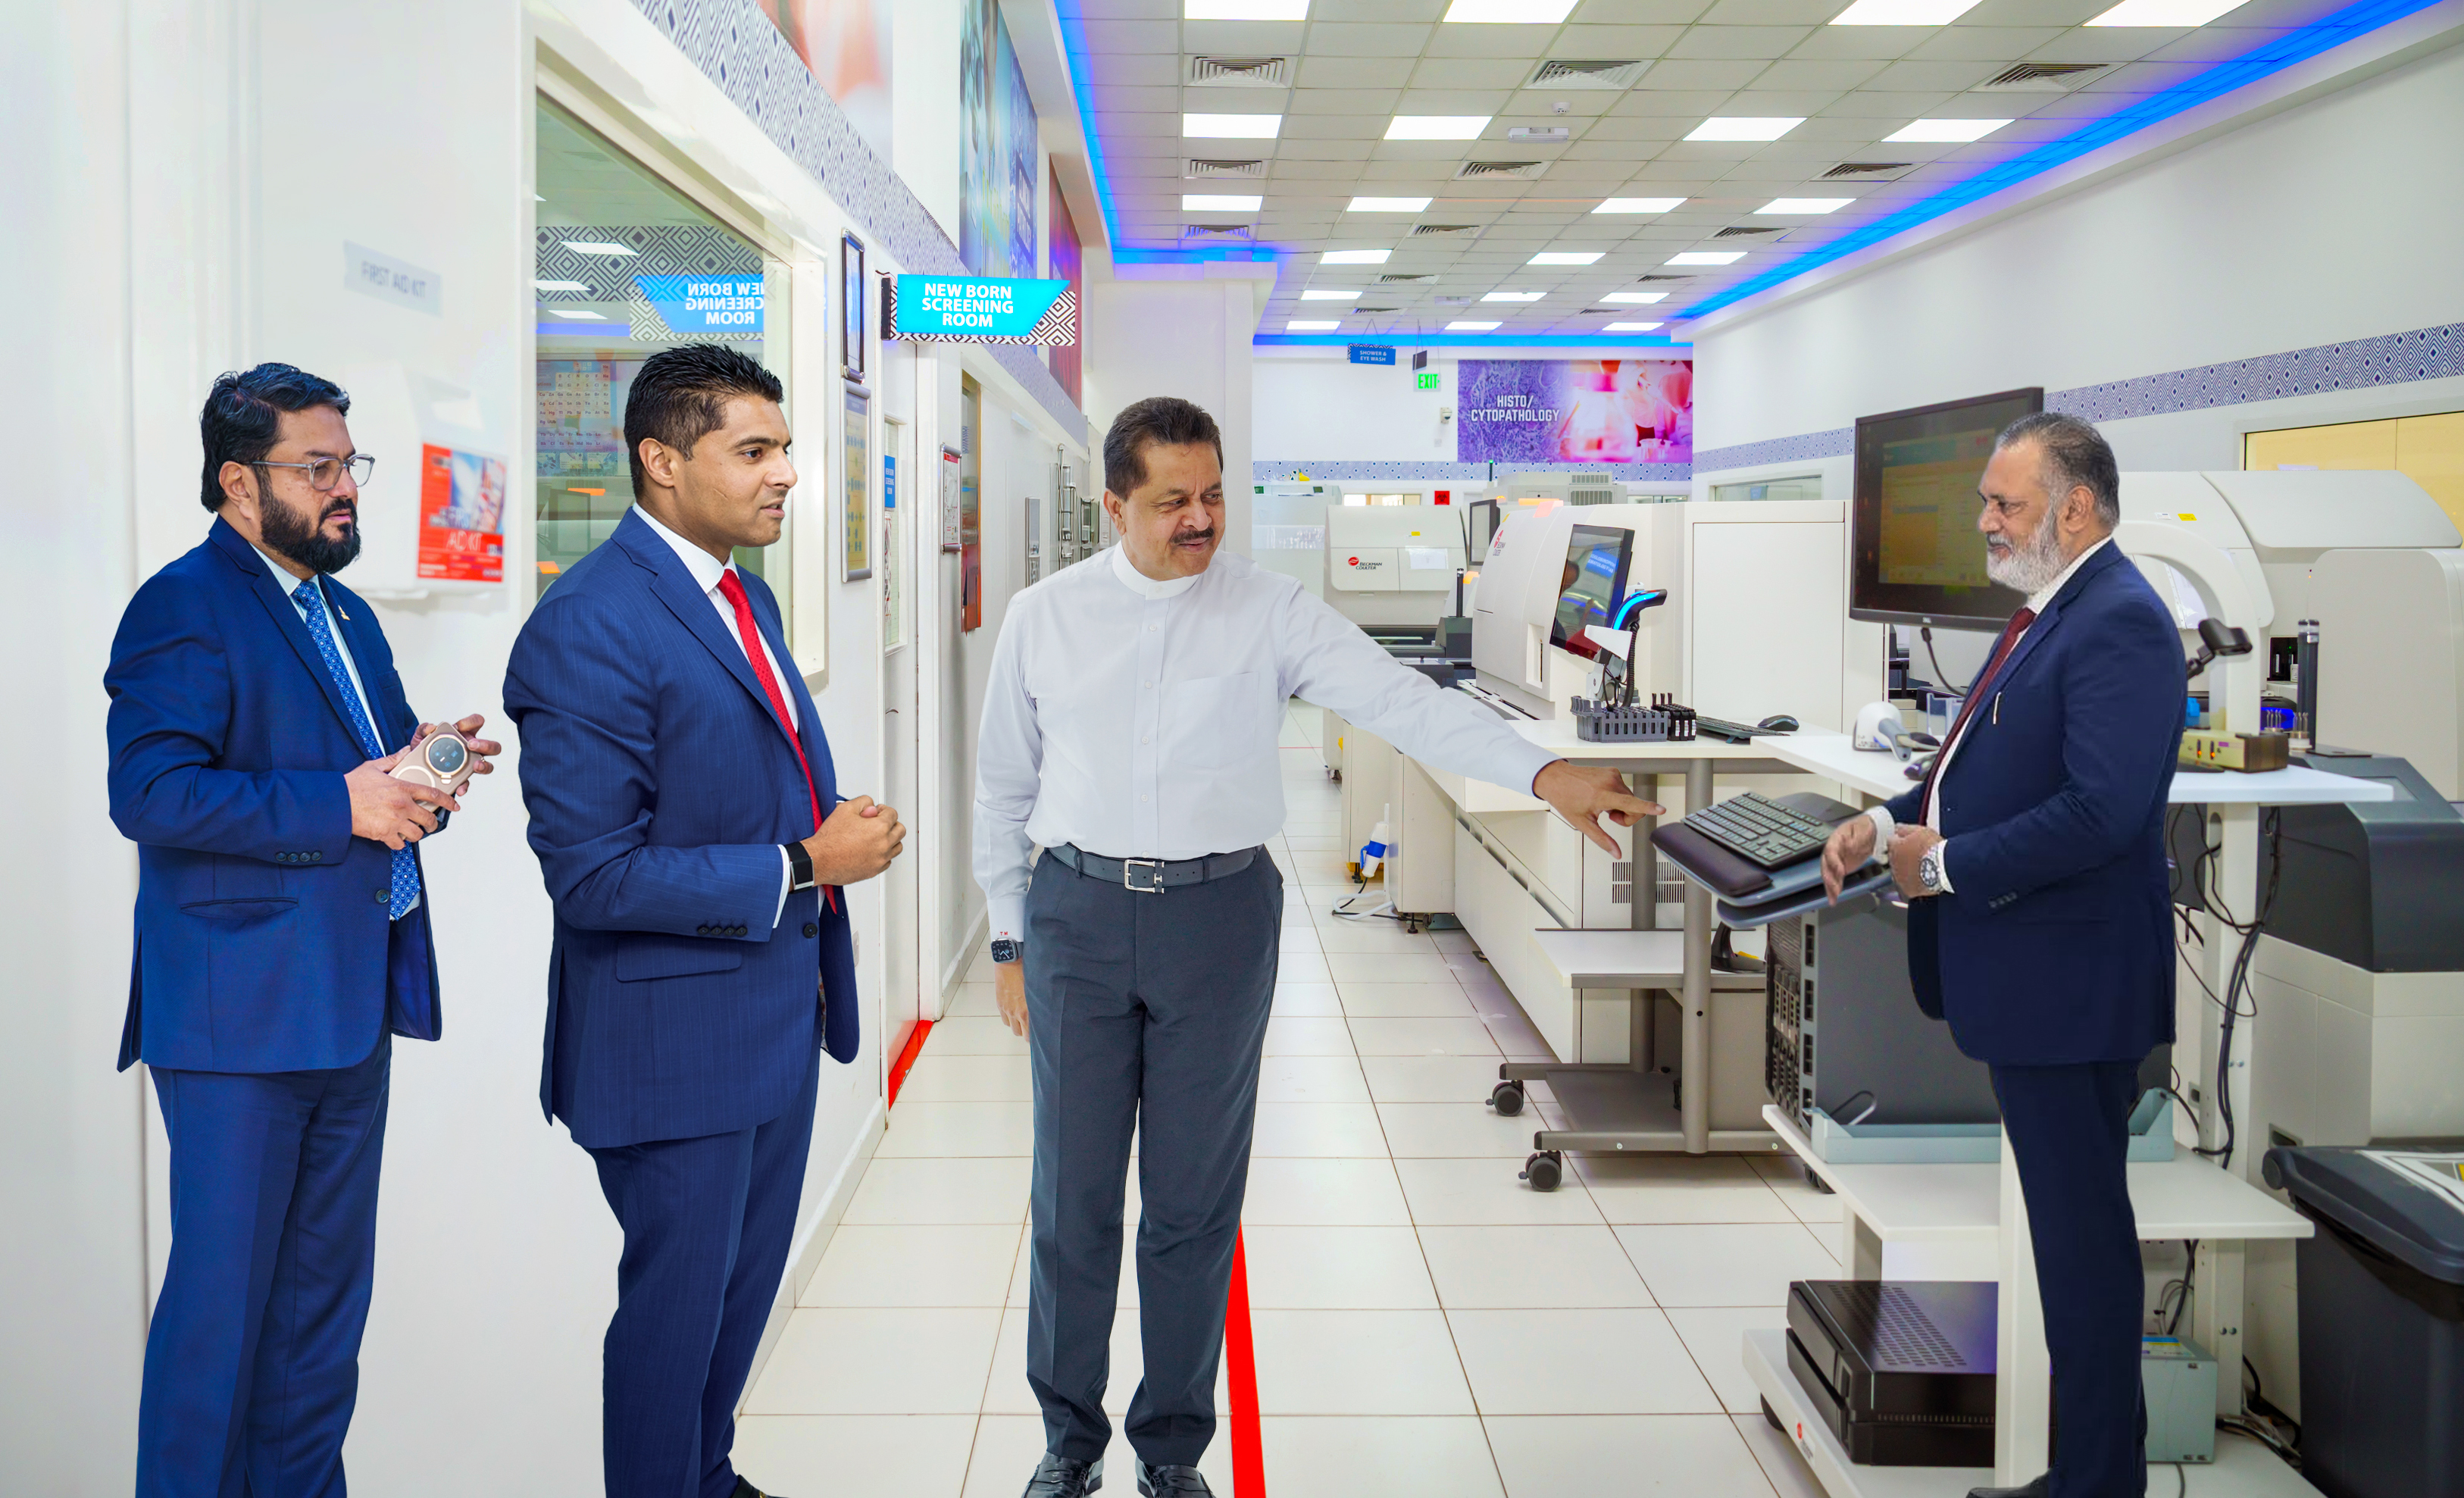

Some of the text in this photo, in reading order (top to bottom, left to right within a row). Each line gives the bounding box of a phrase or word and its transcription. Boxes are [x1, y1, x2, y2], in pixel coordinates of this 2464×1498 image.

[924, 283, 1012, 299] NEW BORN
[921, 298, 1014, 314] SCREENING
[942, 314, 993, 327] ROOM
[1418, 374, 1438, 389] EXIT
[1496, 395, 1534, 408] HISTO/
[1471, 409, 1559, 422] CYTOPATHOLOGY
